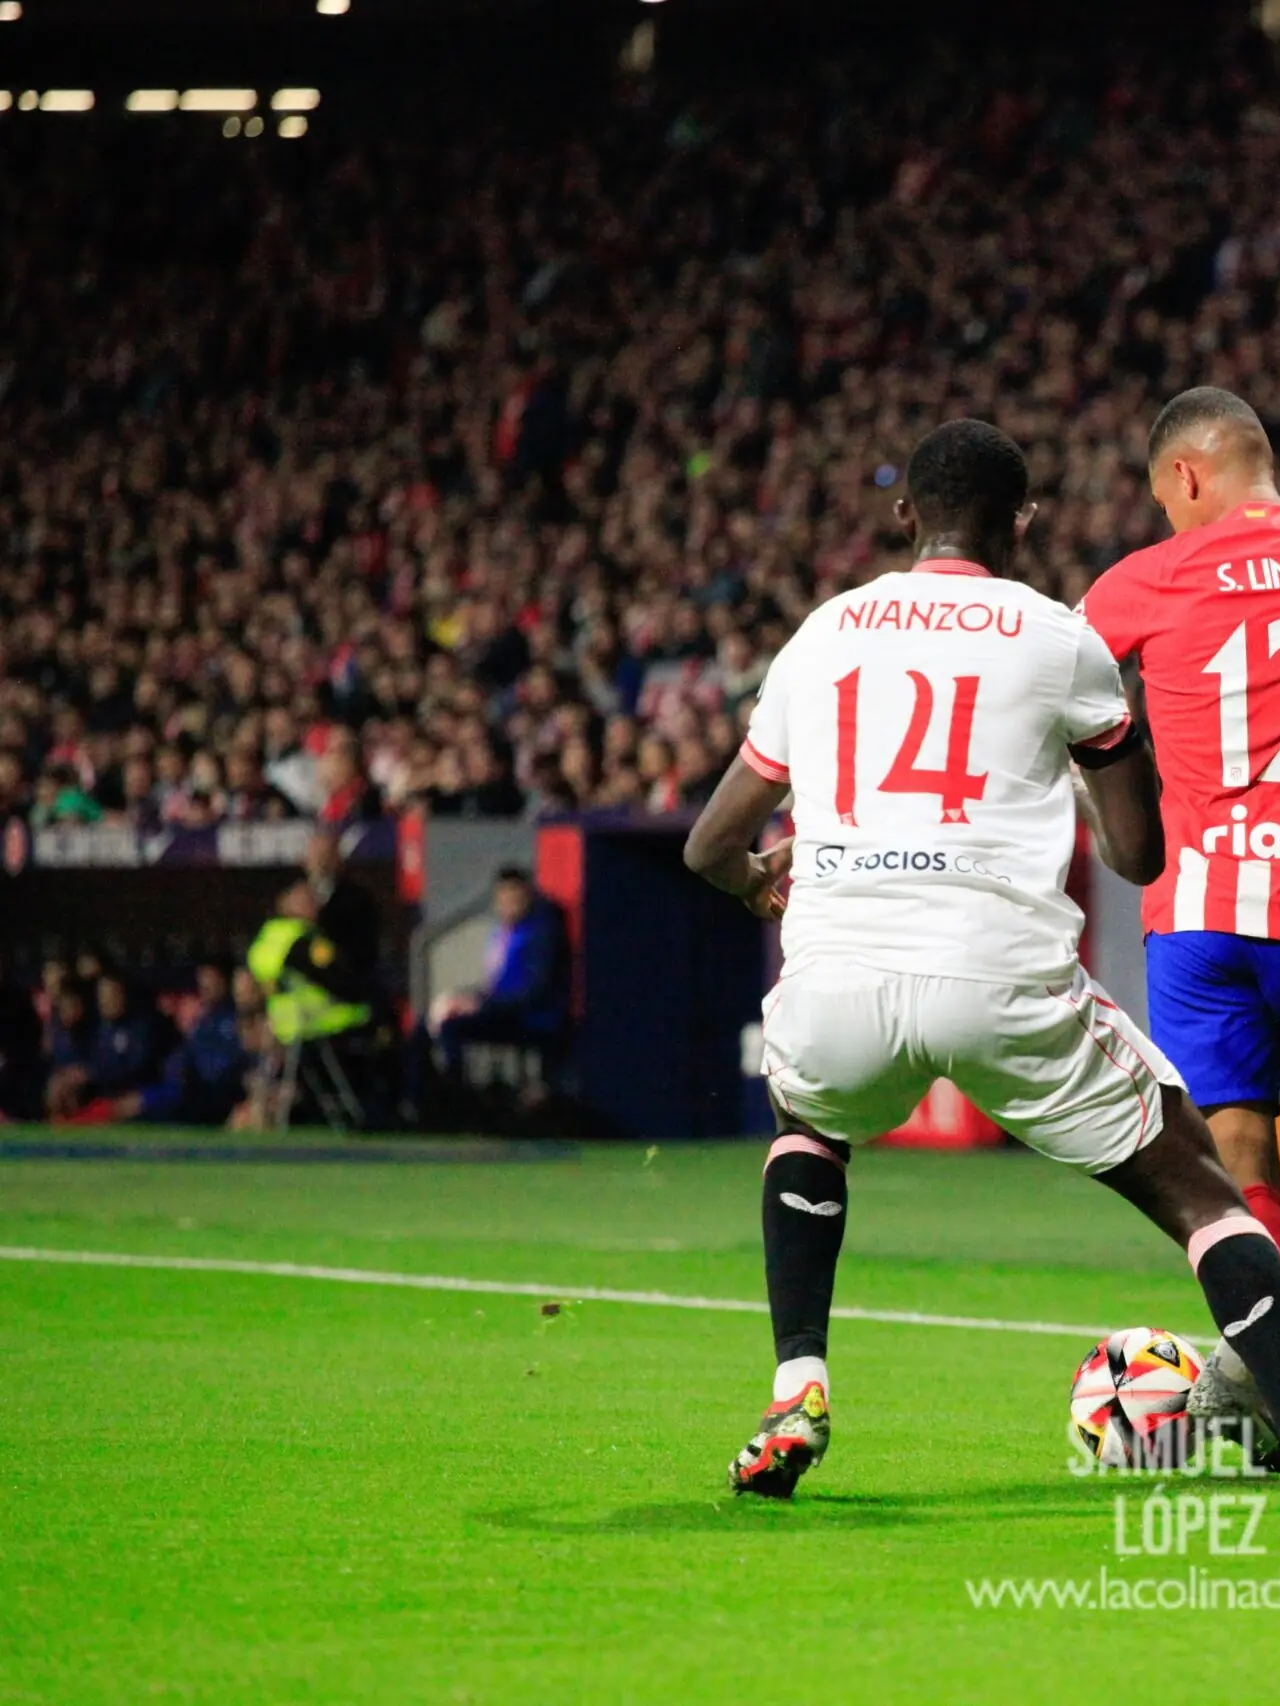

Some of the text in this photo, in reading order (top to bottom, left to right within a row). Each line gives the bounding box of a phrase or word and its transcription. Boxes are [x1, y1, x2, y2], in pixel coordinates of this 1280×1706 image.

[1217, 560, 1244, 592] S.
[837, 600, 1023, 638] NIANZOU
[834, 666, 989, 828] 14
